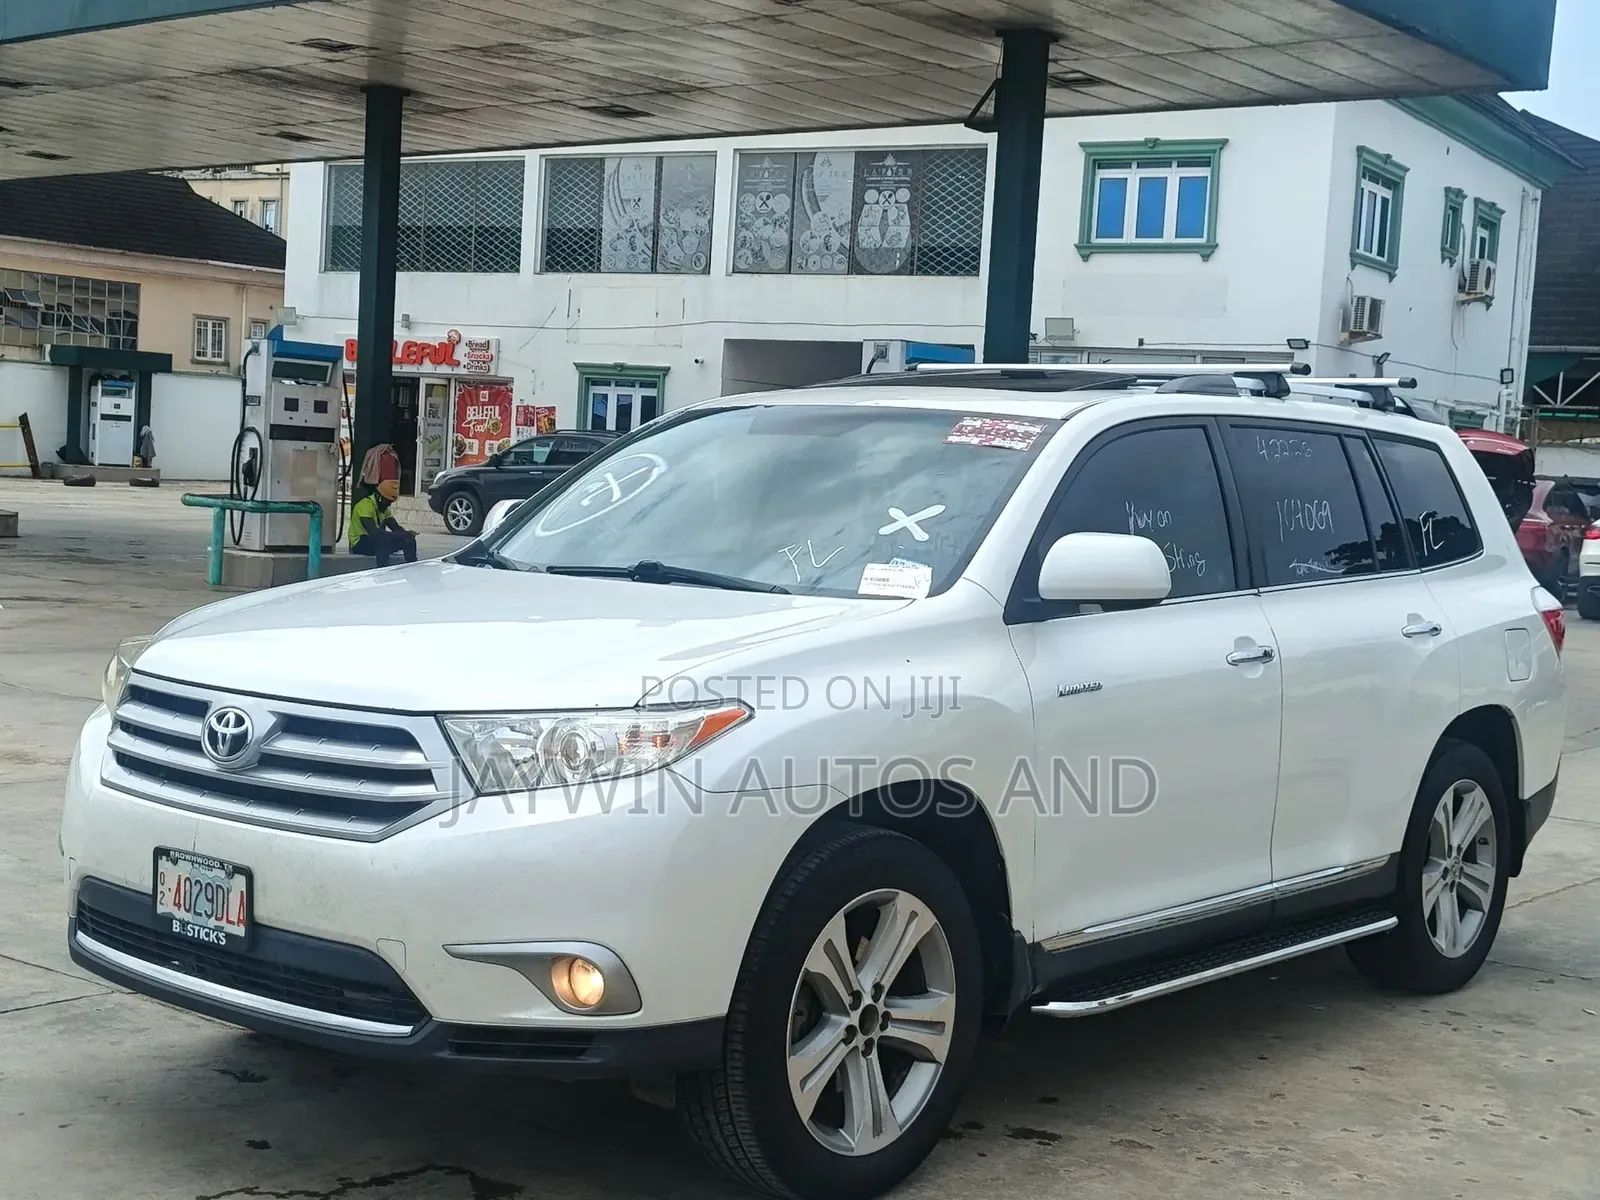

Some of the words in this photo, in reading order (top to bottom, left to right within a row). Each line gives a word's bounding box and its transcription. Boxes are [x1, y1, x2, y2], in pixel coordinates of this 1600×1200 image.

[345, 339, 461, 367] BLEFUL
[467, 352, 490, 360] Snacks
[467, 363, 487, 371] Drinks
[173, 874, 247, 928] 4029DLA
